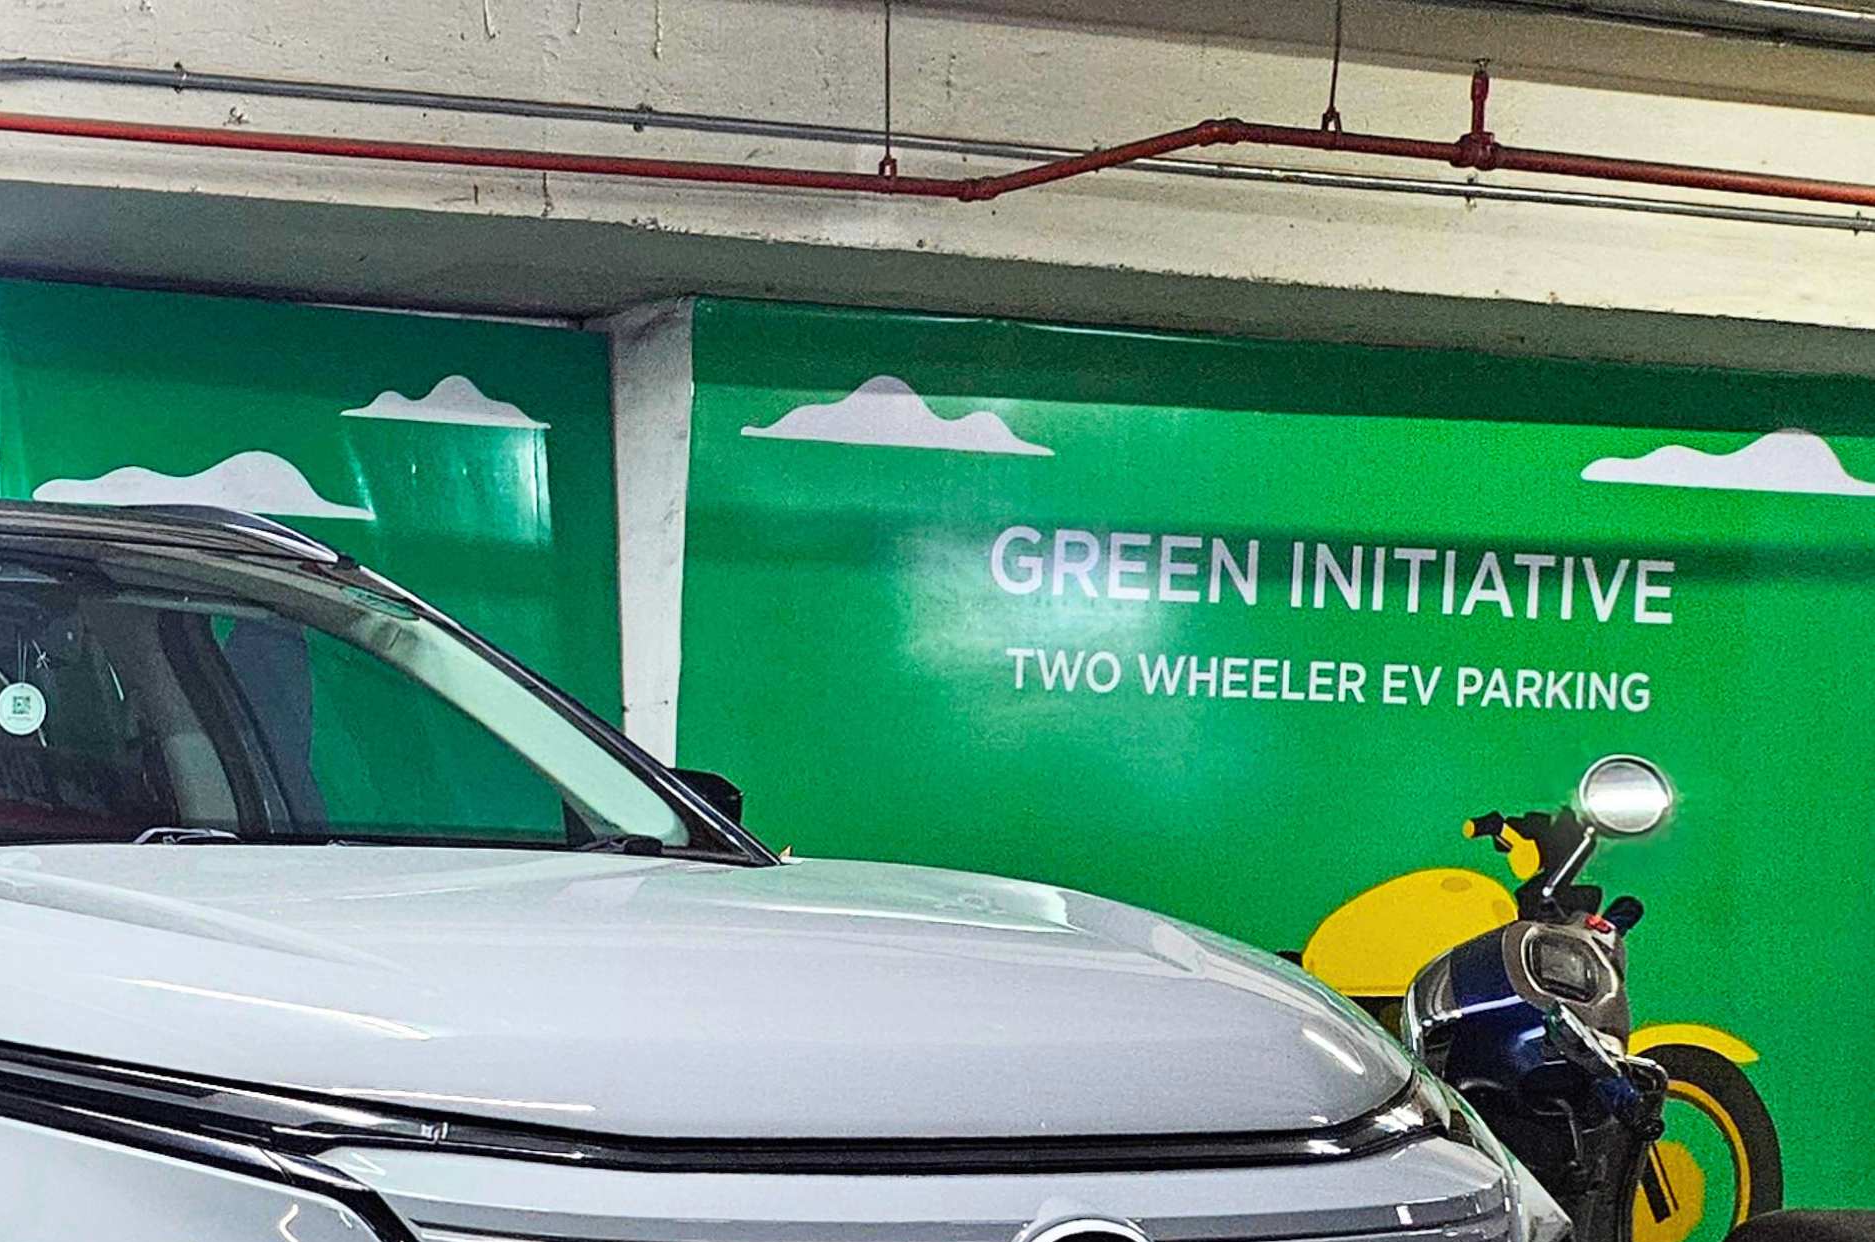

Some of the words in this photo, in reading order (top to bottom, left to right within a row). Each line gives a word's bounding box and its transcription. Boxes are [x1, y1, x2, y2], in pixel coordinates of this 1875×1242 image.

[989, 525, 1259, 605] GREEN
[1289, 541, 1675, 625] INITIATIVE
[1006, 648, 1122, 694] TWO
[1137, 652, 1367, 704] WHEELER
[1382, 664, 1442, 706] EV
[1456, 667, 1651, 713] PARKING
